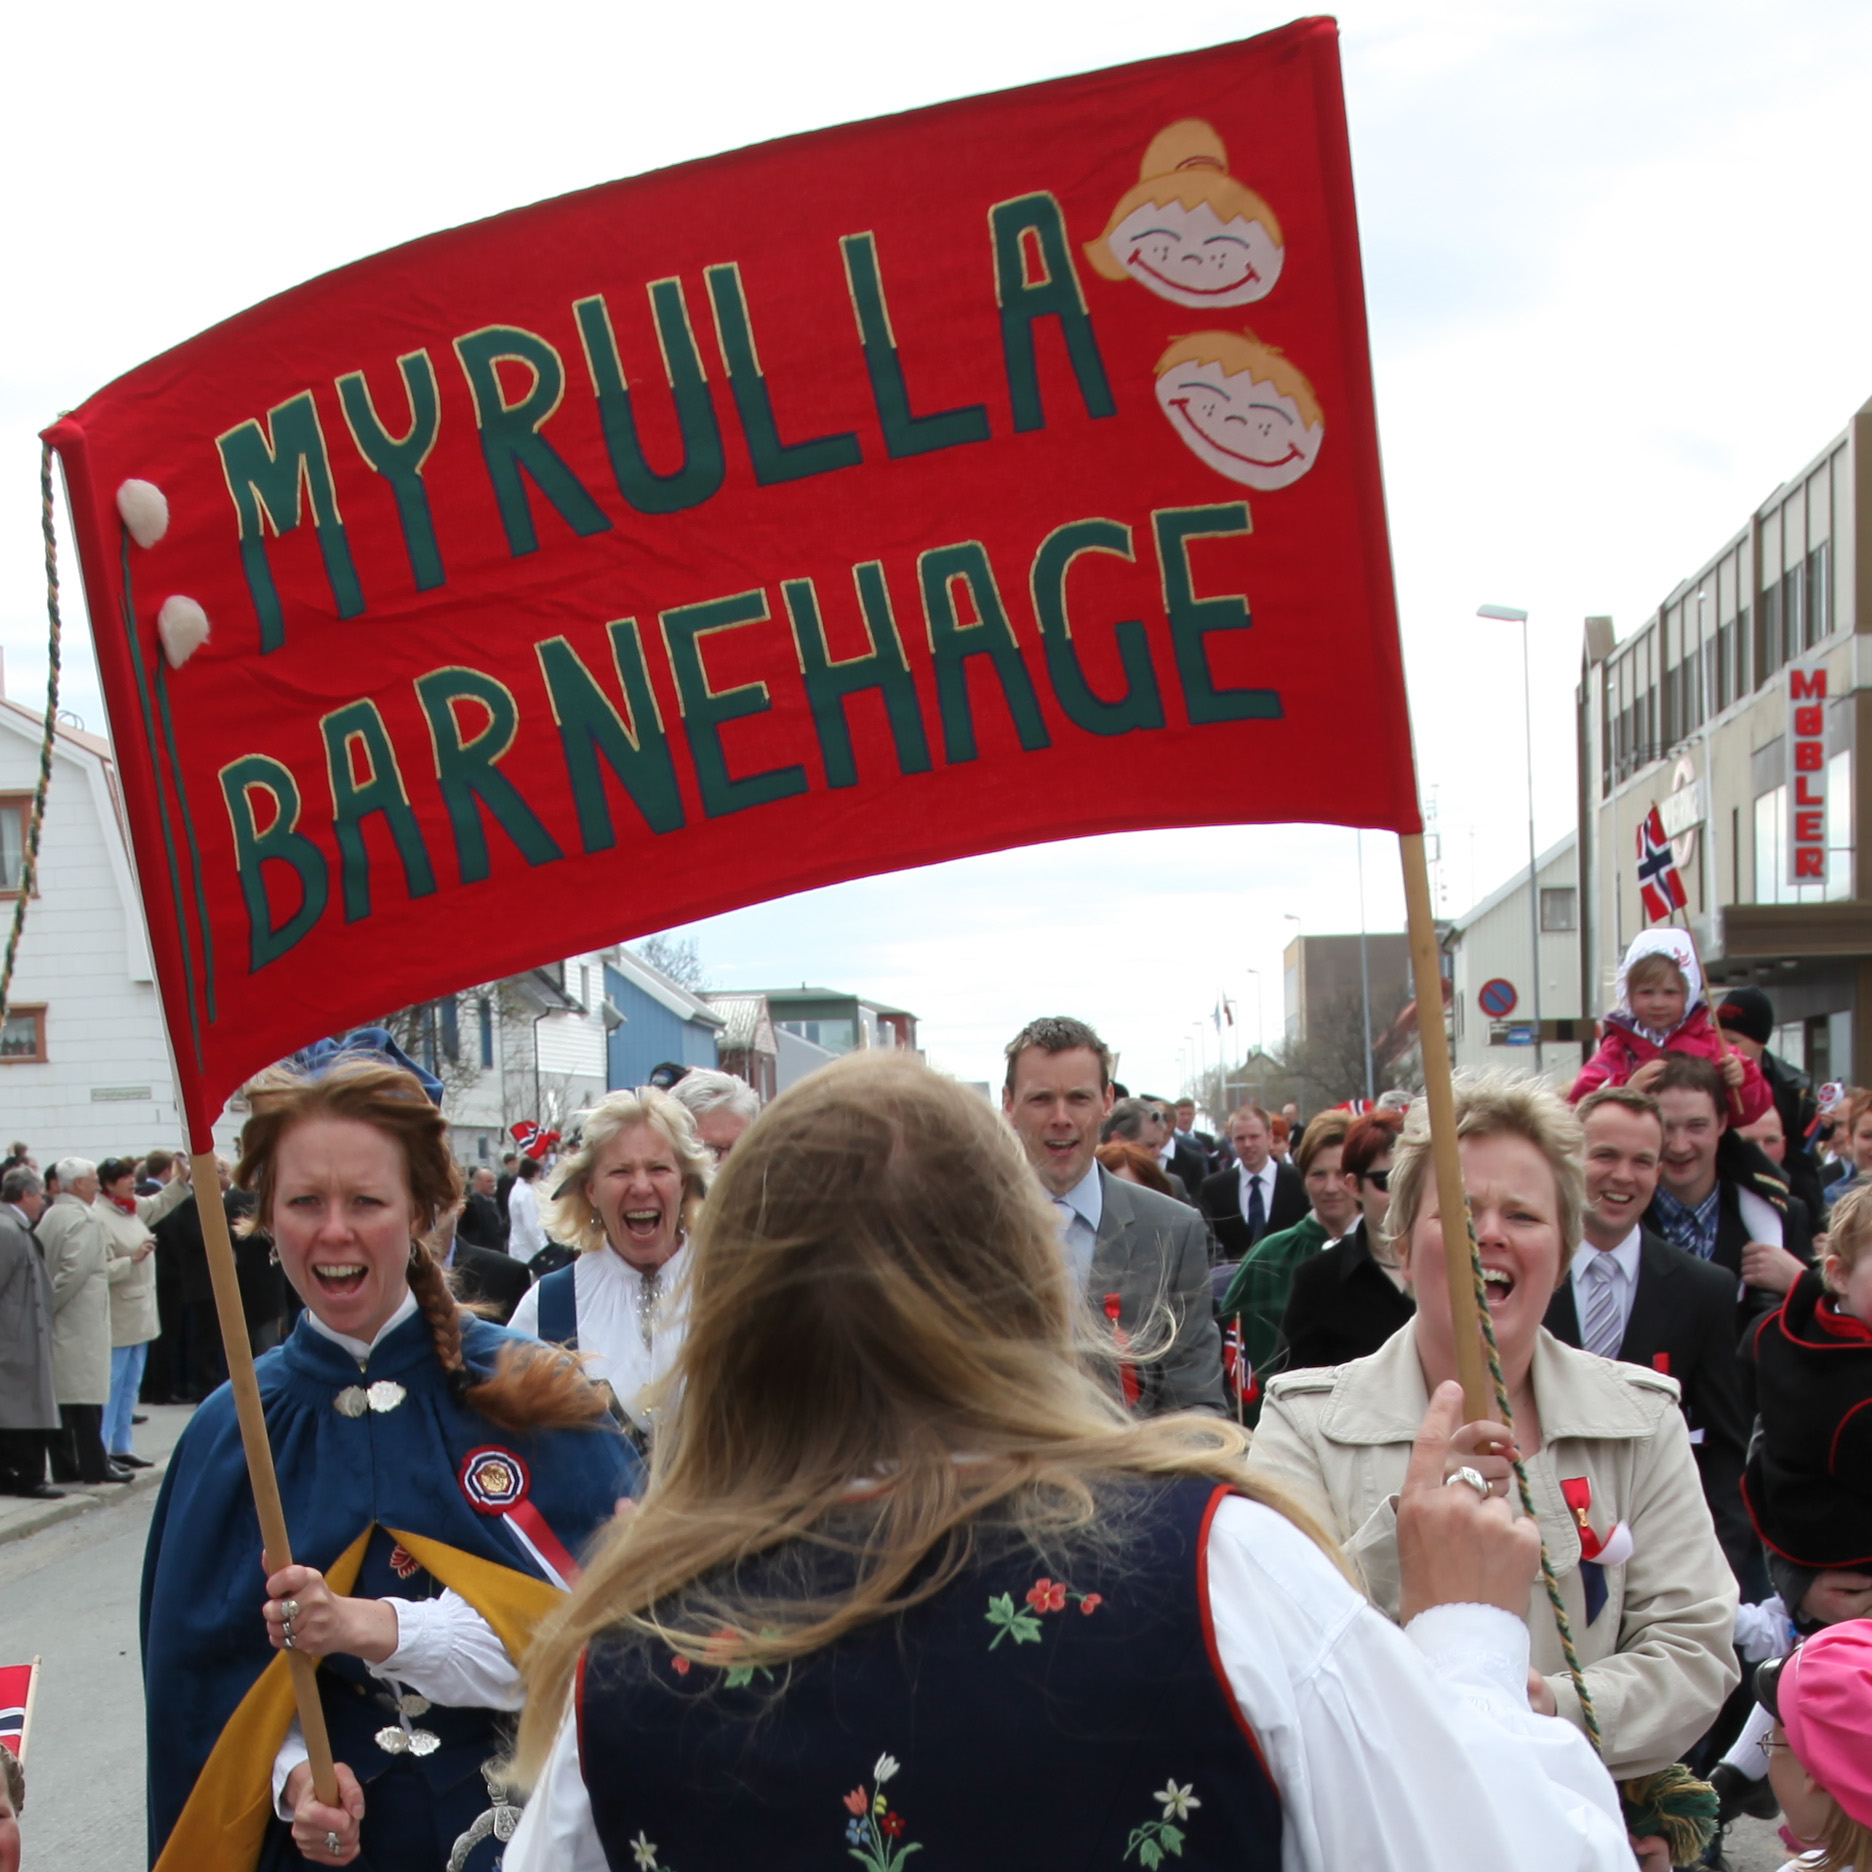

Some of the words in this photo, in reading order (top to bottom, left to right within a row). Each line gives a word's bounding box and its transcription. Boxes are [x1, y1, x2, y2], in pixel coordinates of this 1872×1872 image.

[216, 191, 1117, 655] MYRULLA
[218, 501, 1284, 975] BARNEHAGE
[1790, 668, 1827, 878] MØBLER
